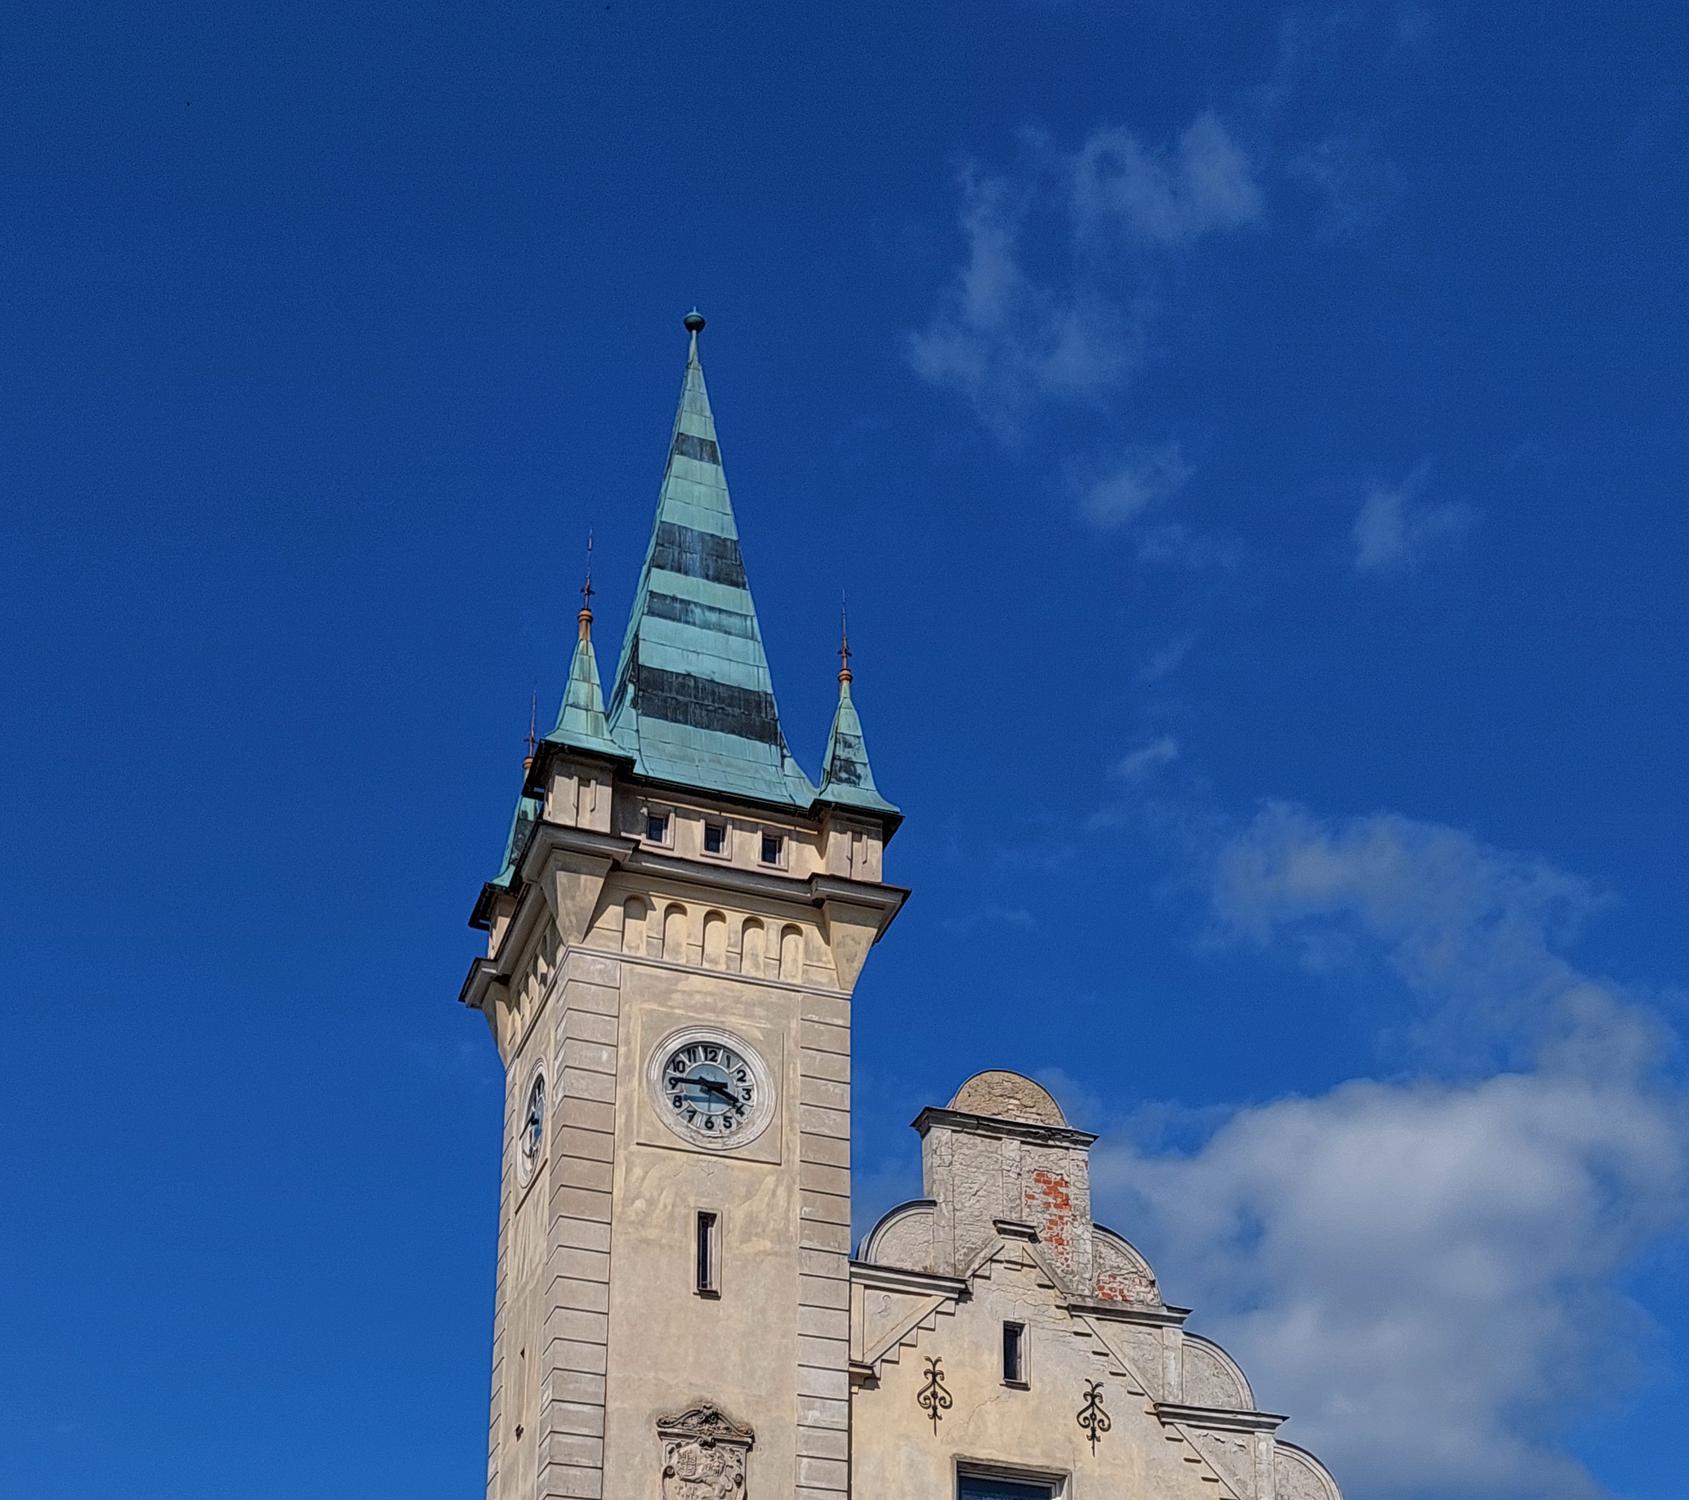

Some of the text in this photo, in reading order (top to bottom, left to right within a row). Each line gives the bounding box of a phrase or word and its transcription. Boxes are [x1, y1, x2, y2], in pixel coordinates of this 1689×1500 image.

[687, 1047, 697, 1062] 11
[704, 1048, 718, 1062] 12
[671, 1057, 686, 1073] 10
[726, 1055, 731, 1068] 1
[736, 1069, 747, 1082] 2
[668, 1077, 679, 1090] 9
[741, 1088, 752, 1101] 3
[672, 1095, 683, 1108] 8
[686, 1110, 697, 1123] 7
[735, 1103, 745, 1117] 4
[704, 1116, 715, 1130] 6
[722, 1116, 733, 1129] 5
